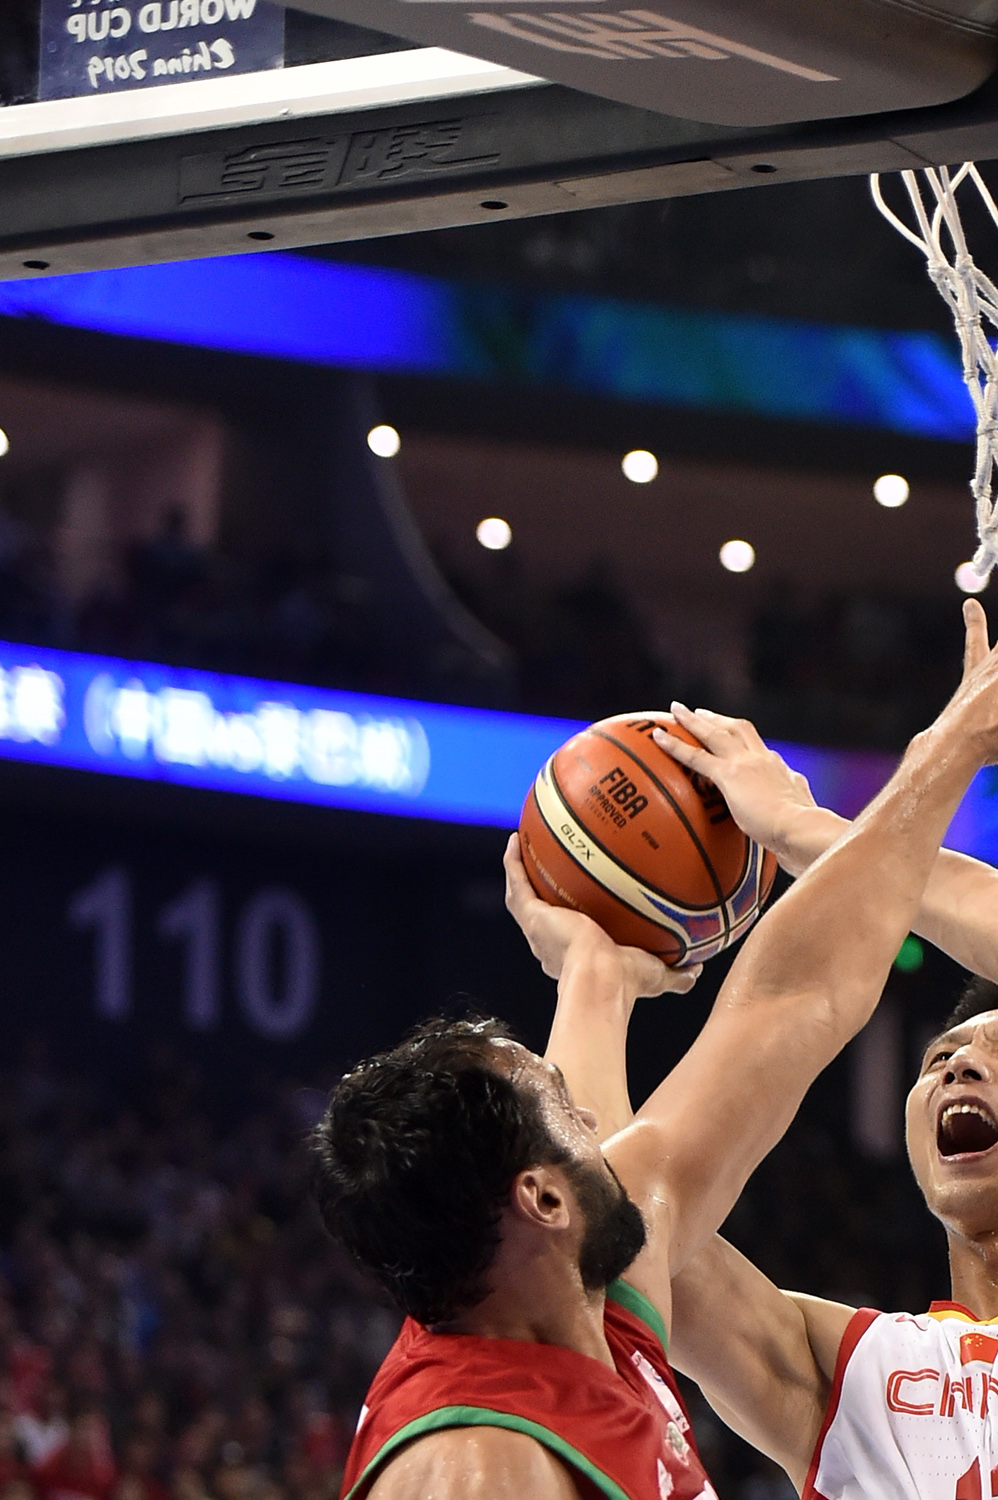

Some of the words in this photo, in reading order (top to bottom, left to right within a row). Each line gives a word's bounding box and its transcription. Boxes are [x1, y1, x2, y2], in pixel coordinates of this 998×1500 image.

[588, 784, 628, 829] APPROVED
[599, 766, 649, 819] FIBA
[560, 823, 596, 862] GL7X
[66, 866, 321, 1041] 110
